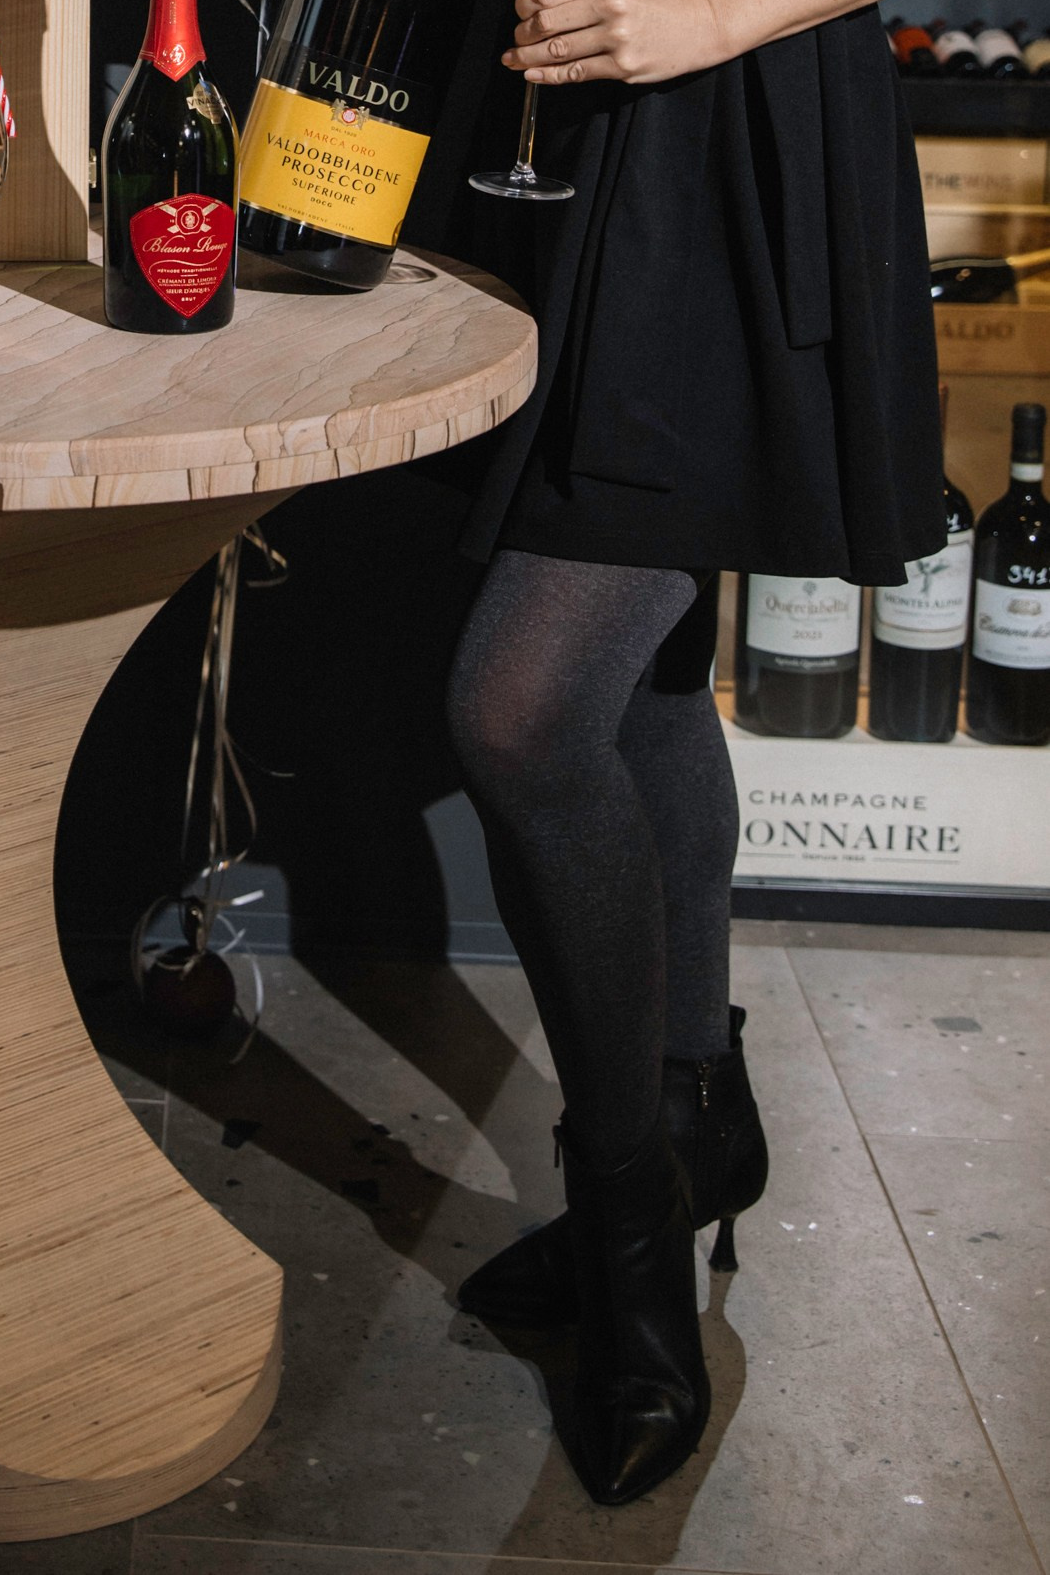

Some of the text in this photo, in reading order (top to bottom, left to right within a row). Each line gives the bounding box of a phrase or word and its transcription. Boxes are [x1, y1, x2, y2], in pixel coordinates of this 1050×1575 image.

[308, 61, 410, 113] VALDO
[303, 128, 376, 158] MARCA ORO
[267, 132, 401, 186] VALDOBBIADENE
[282, 156, 376, 195] PROSECCO
[292, 177, 357, 206] SUPERIORE
[310, 197, 333, 208] DOCG
[142, 235, 228, 258] Blason Rouge
[943, 319, 1014, 340] ALDO
[1007, 564, 1050, 586] 341
[748, 789, 928, 811] CHAMPAGNE
[745, 818, 961, 854] ONNAIRE
